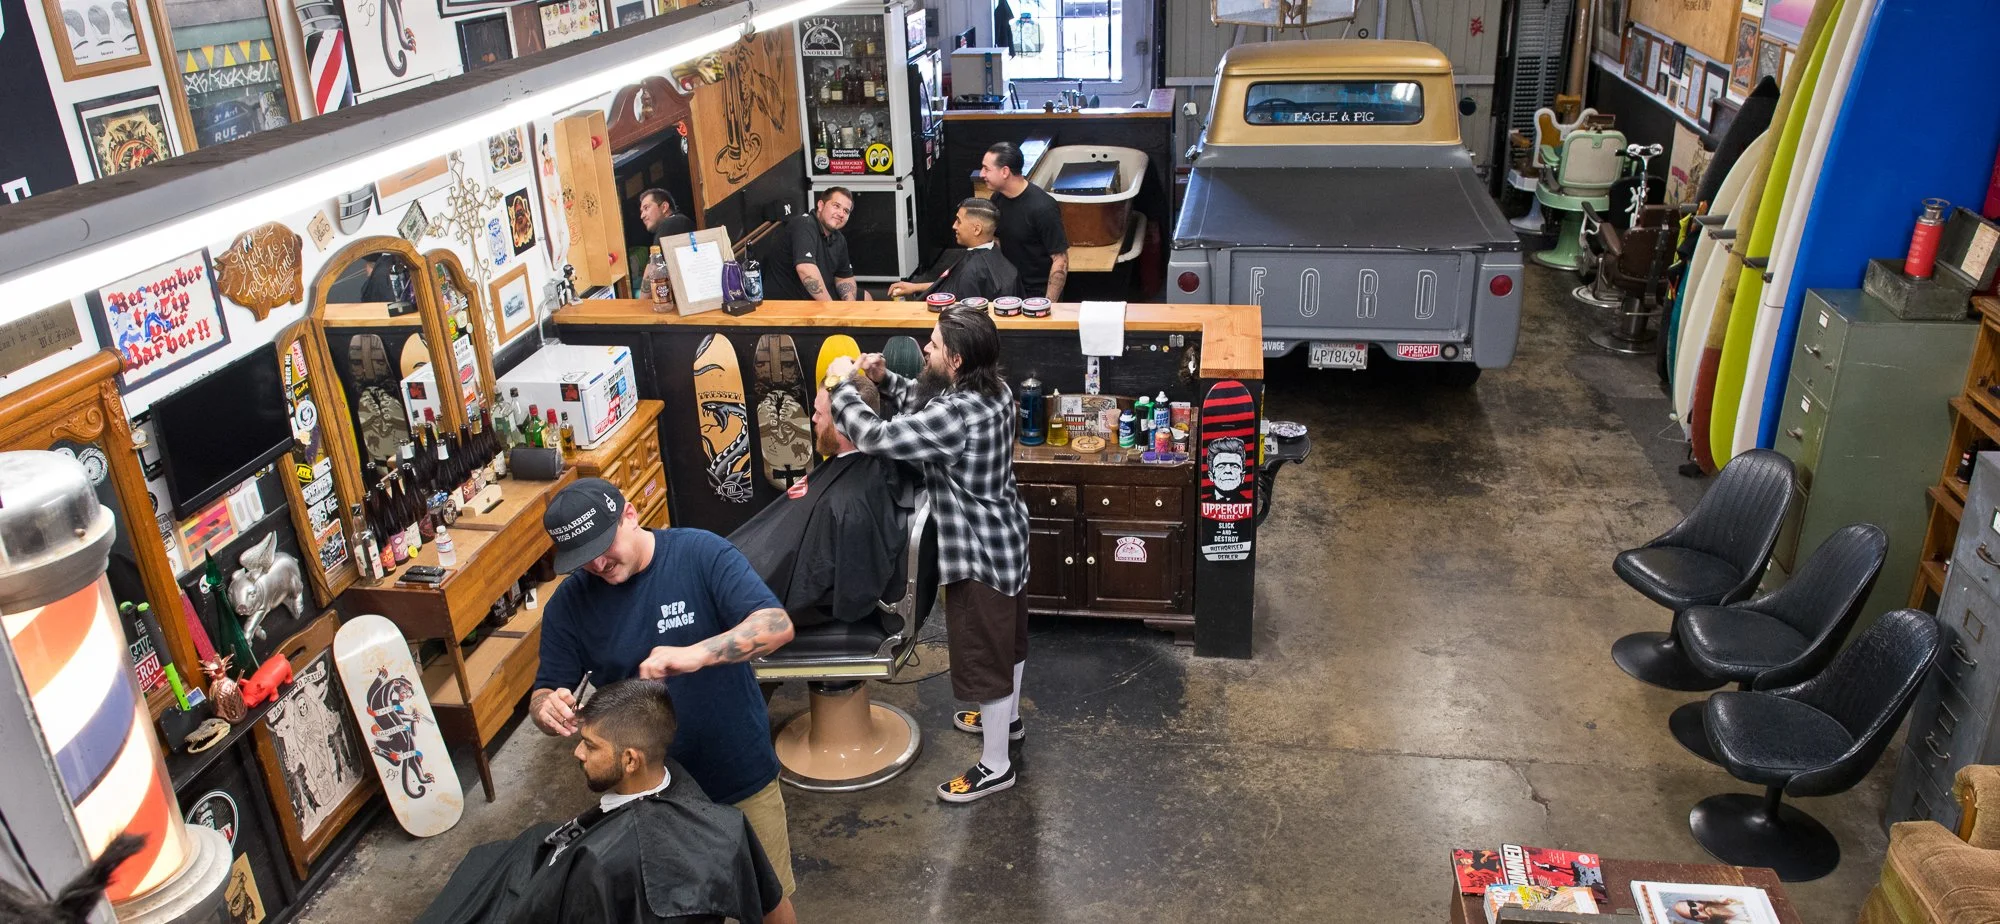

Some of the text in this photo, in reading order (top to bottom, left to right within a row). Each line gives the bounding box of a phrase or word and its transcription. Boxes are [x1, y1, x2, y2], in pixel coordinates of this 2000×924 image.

[803, 17, 840, 30] BUTT
[1294, 111, 1375, 122] EAGLE & PIG
[214, 125, 238, 143] RUE
[1250, 266, 1438, 320] FORD
[158, 291, 190, 320] Tip
[124, 317, 211, 375] Barber!!
[1262, 341, 1285, 351] AVAGE
[1399, 345, 1438, 355] UPPERCUT
[1313, 349, 1363, 363] 4P78494
[1201, 502, 1252, 516] UPPERCUT
[562, 507, 597, 532] BARBERS
[571, 519, 595, 538] AGAIN
[1214, 535, 1239, 543] DESTROY
[660, 600, 686, 619] BEER
[657, 611, 695, 634] SAVAGE
[303, 670, 323, 685] DEATH
[1502, 843, 1529, 886] DAMNED
